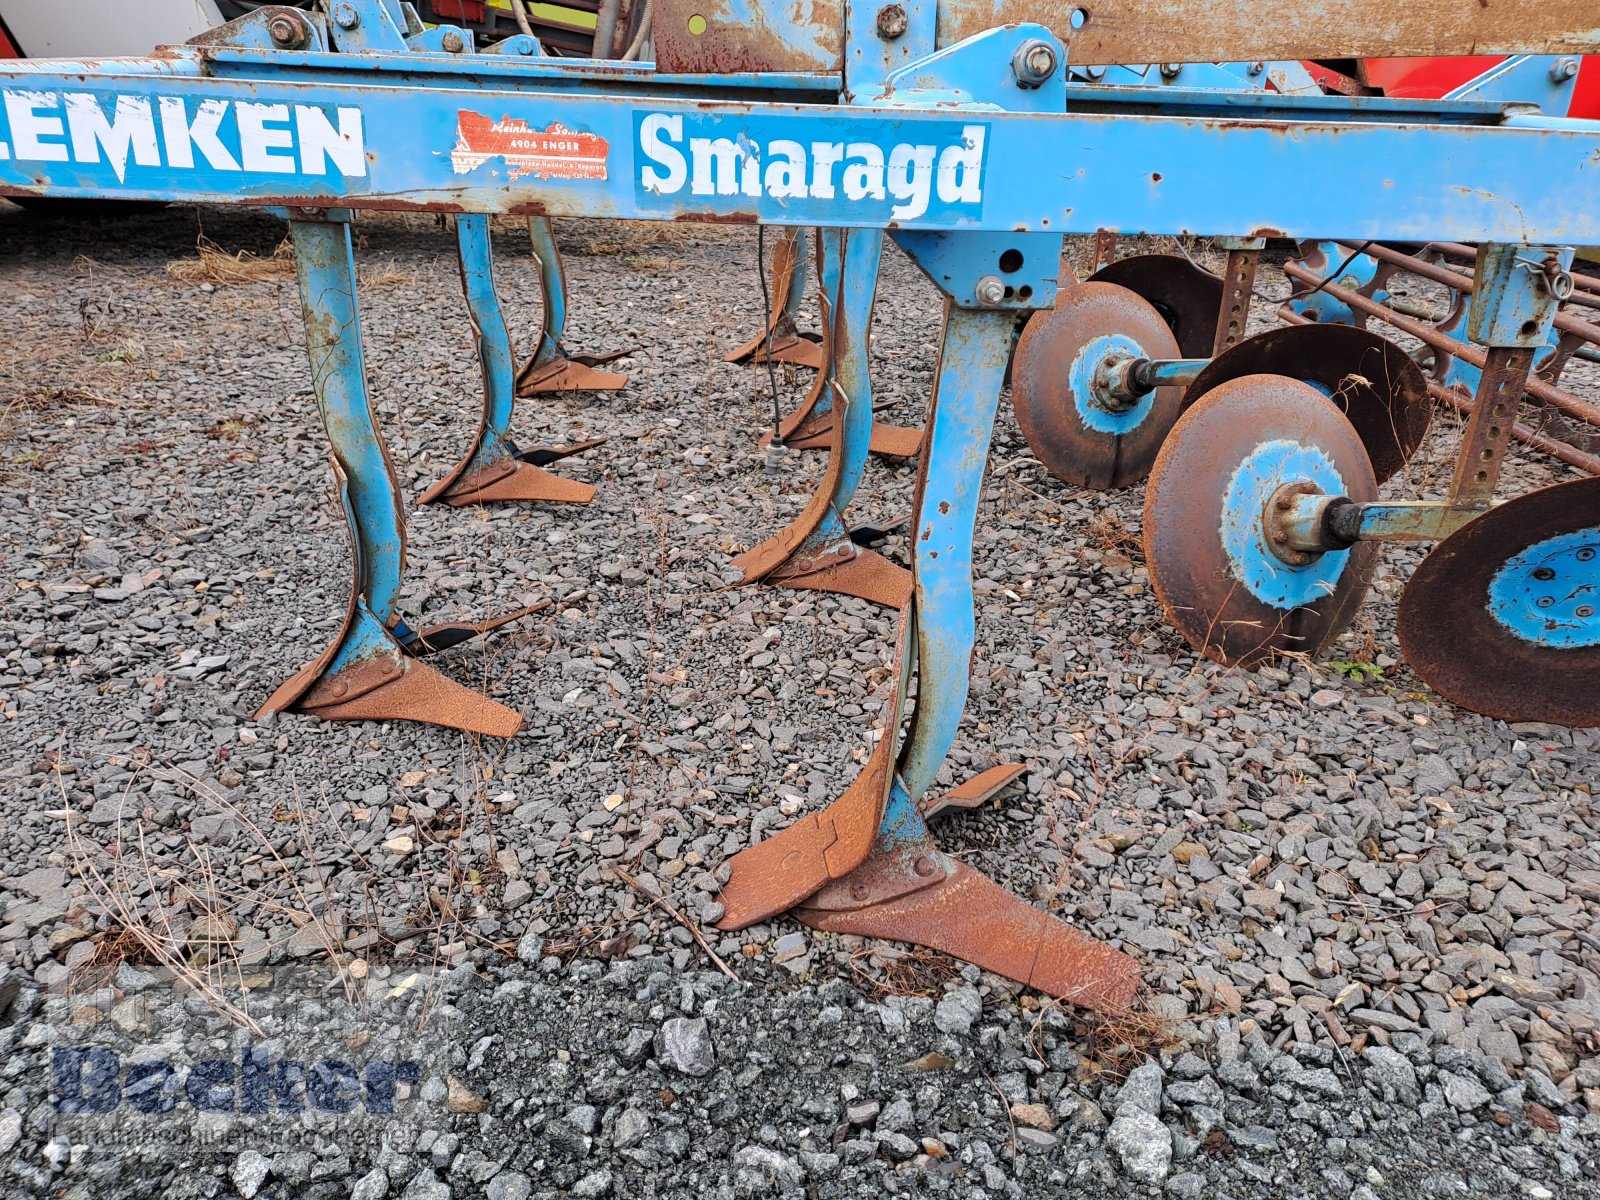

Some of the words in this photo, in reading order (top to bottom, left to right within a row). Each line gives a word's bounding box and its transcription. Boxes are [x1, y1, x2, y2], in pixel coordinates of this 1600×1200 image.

[0, 88, 366, 185] EMKEN
[510, 139, 538, 149] 4904
[542, 141, 580, 151] ENGER
[639, 113, 986, 220] Smaragd
